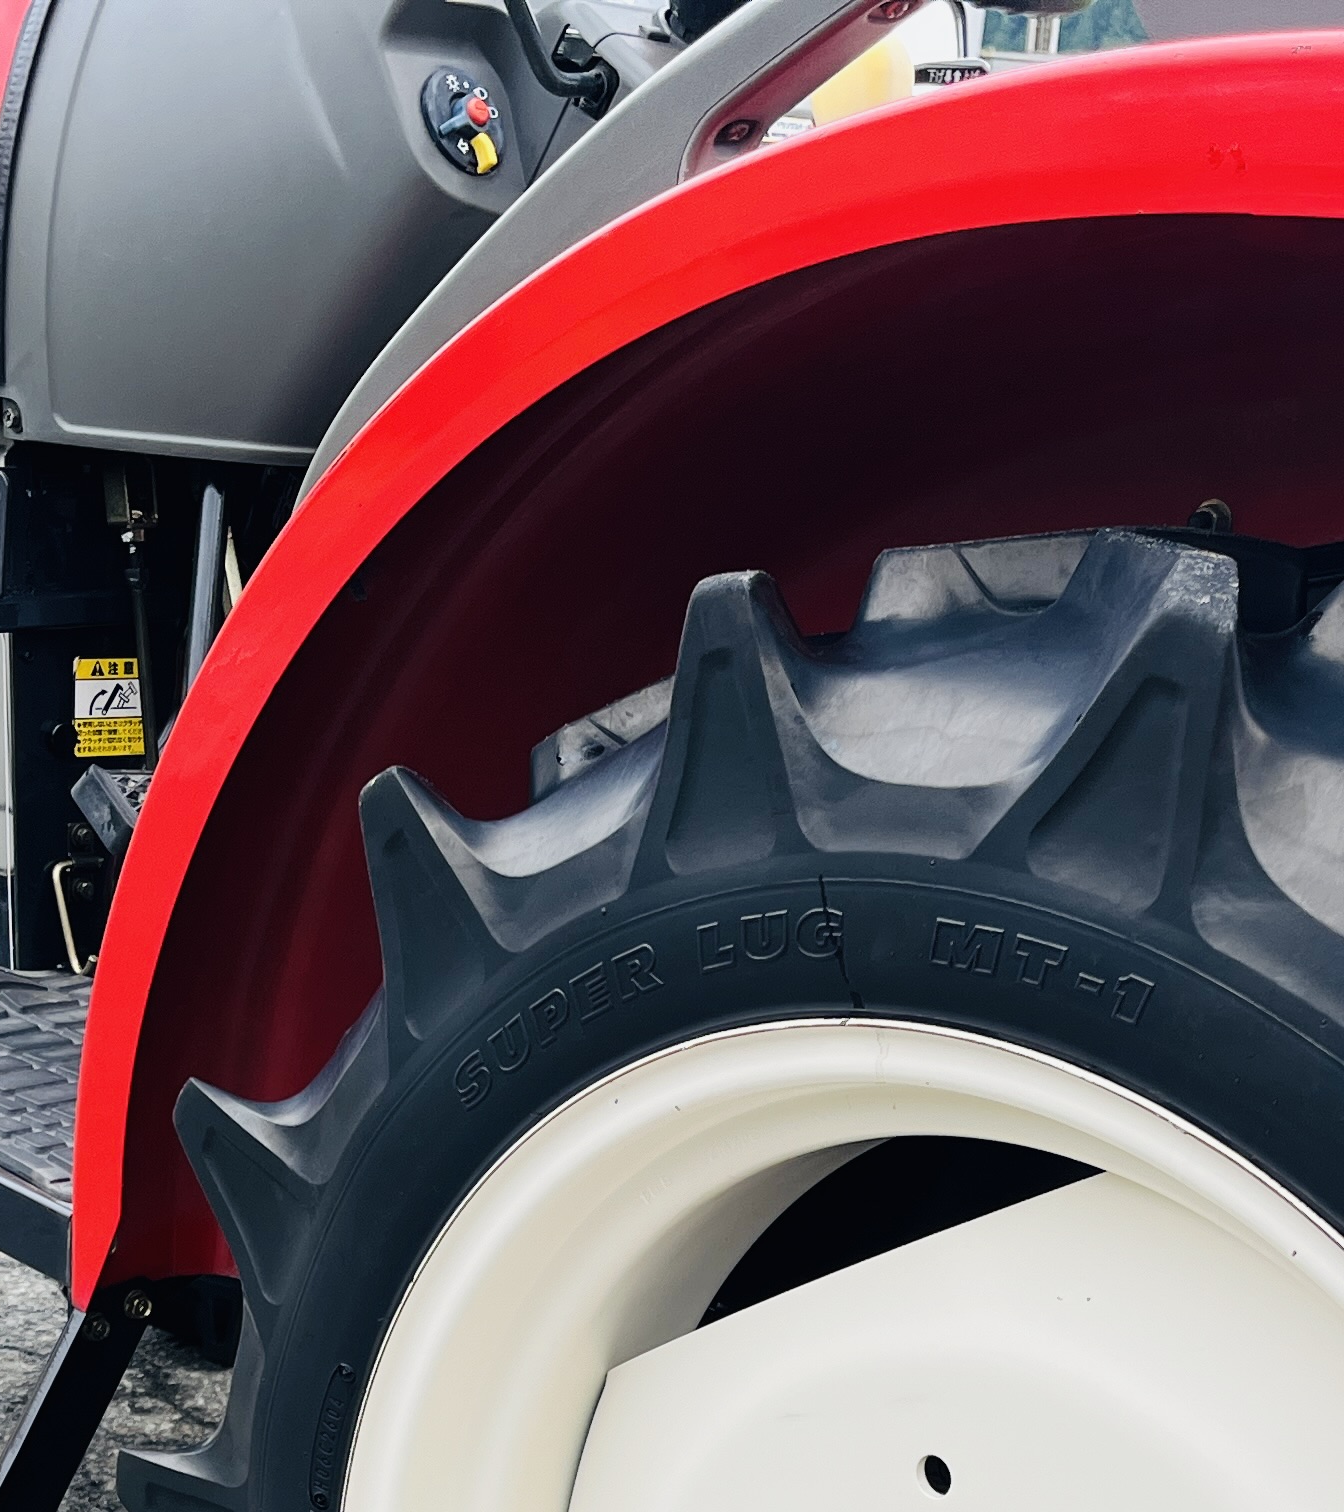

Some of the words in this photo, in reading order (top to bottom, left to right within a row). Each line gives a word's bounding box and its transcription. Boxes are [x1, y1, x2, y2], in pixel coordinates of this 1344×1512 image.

[108, 661, 134, 675] 注意
[452, 943, 665, 1112] SUPER
[695, 908, 844, 975] LUG
[929, 915, 1159, 1027] MT-1
